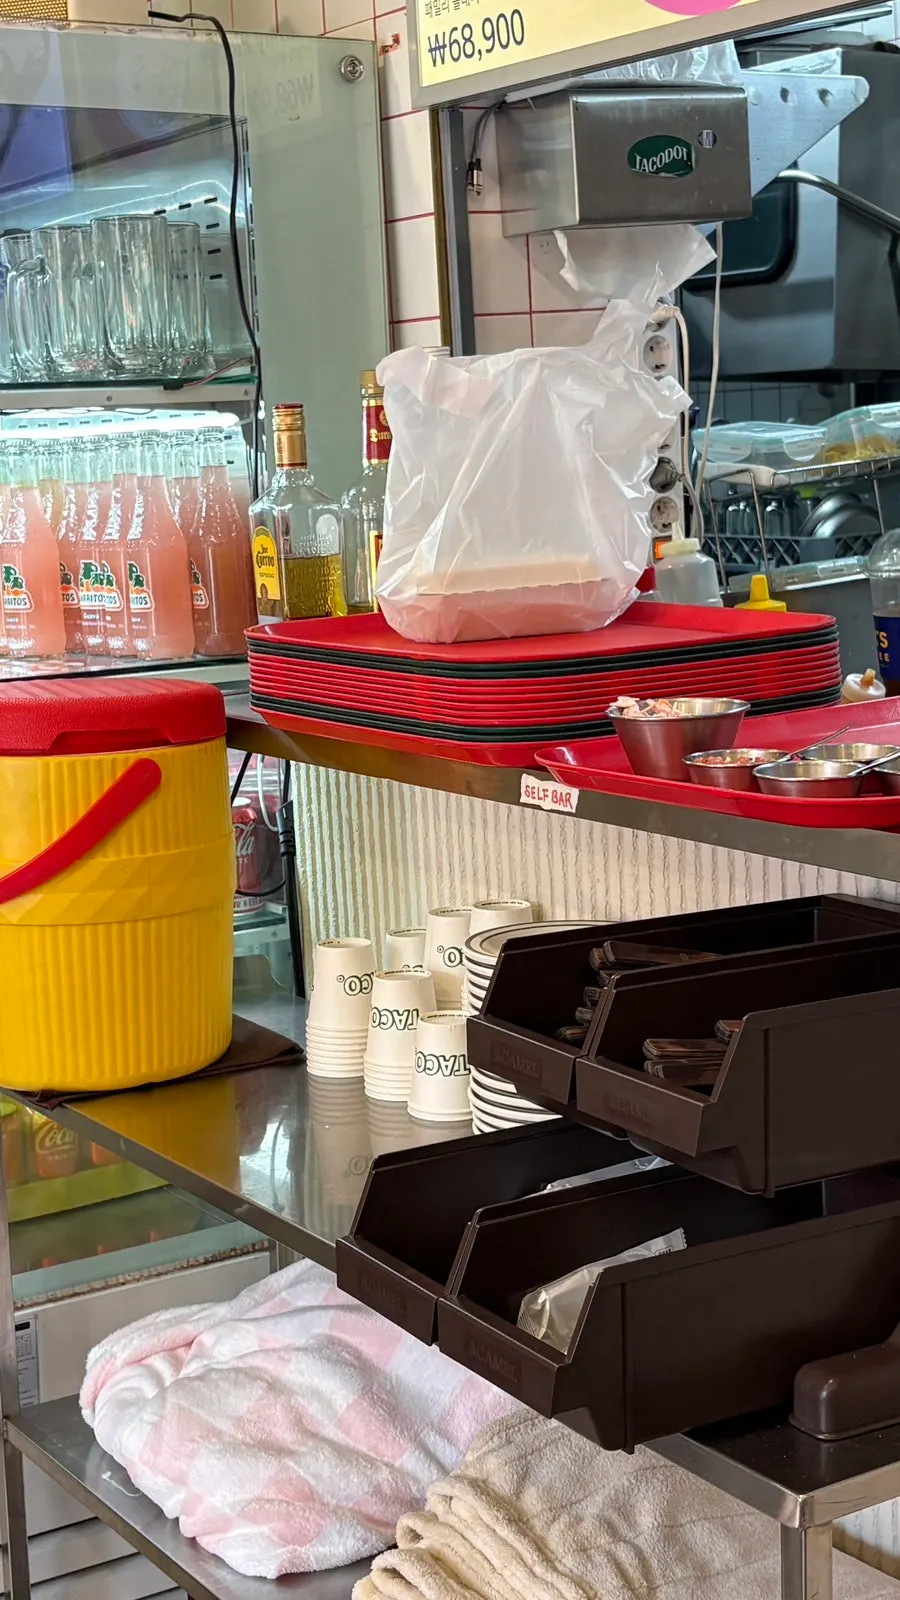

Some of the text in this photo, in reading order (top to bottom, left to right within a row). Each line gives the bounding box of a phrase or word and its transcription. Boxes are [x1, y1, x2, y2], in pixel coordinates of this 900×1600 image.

[428, 9, 525, 67] ₩68,900
[524, 784, 573, 810] SELF BAR
